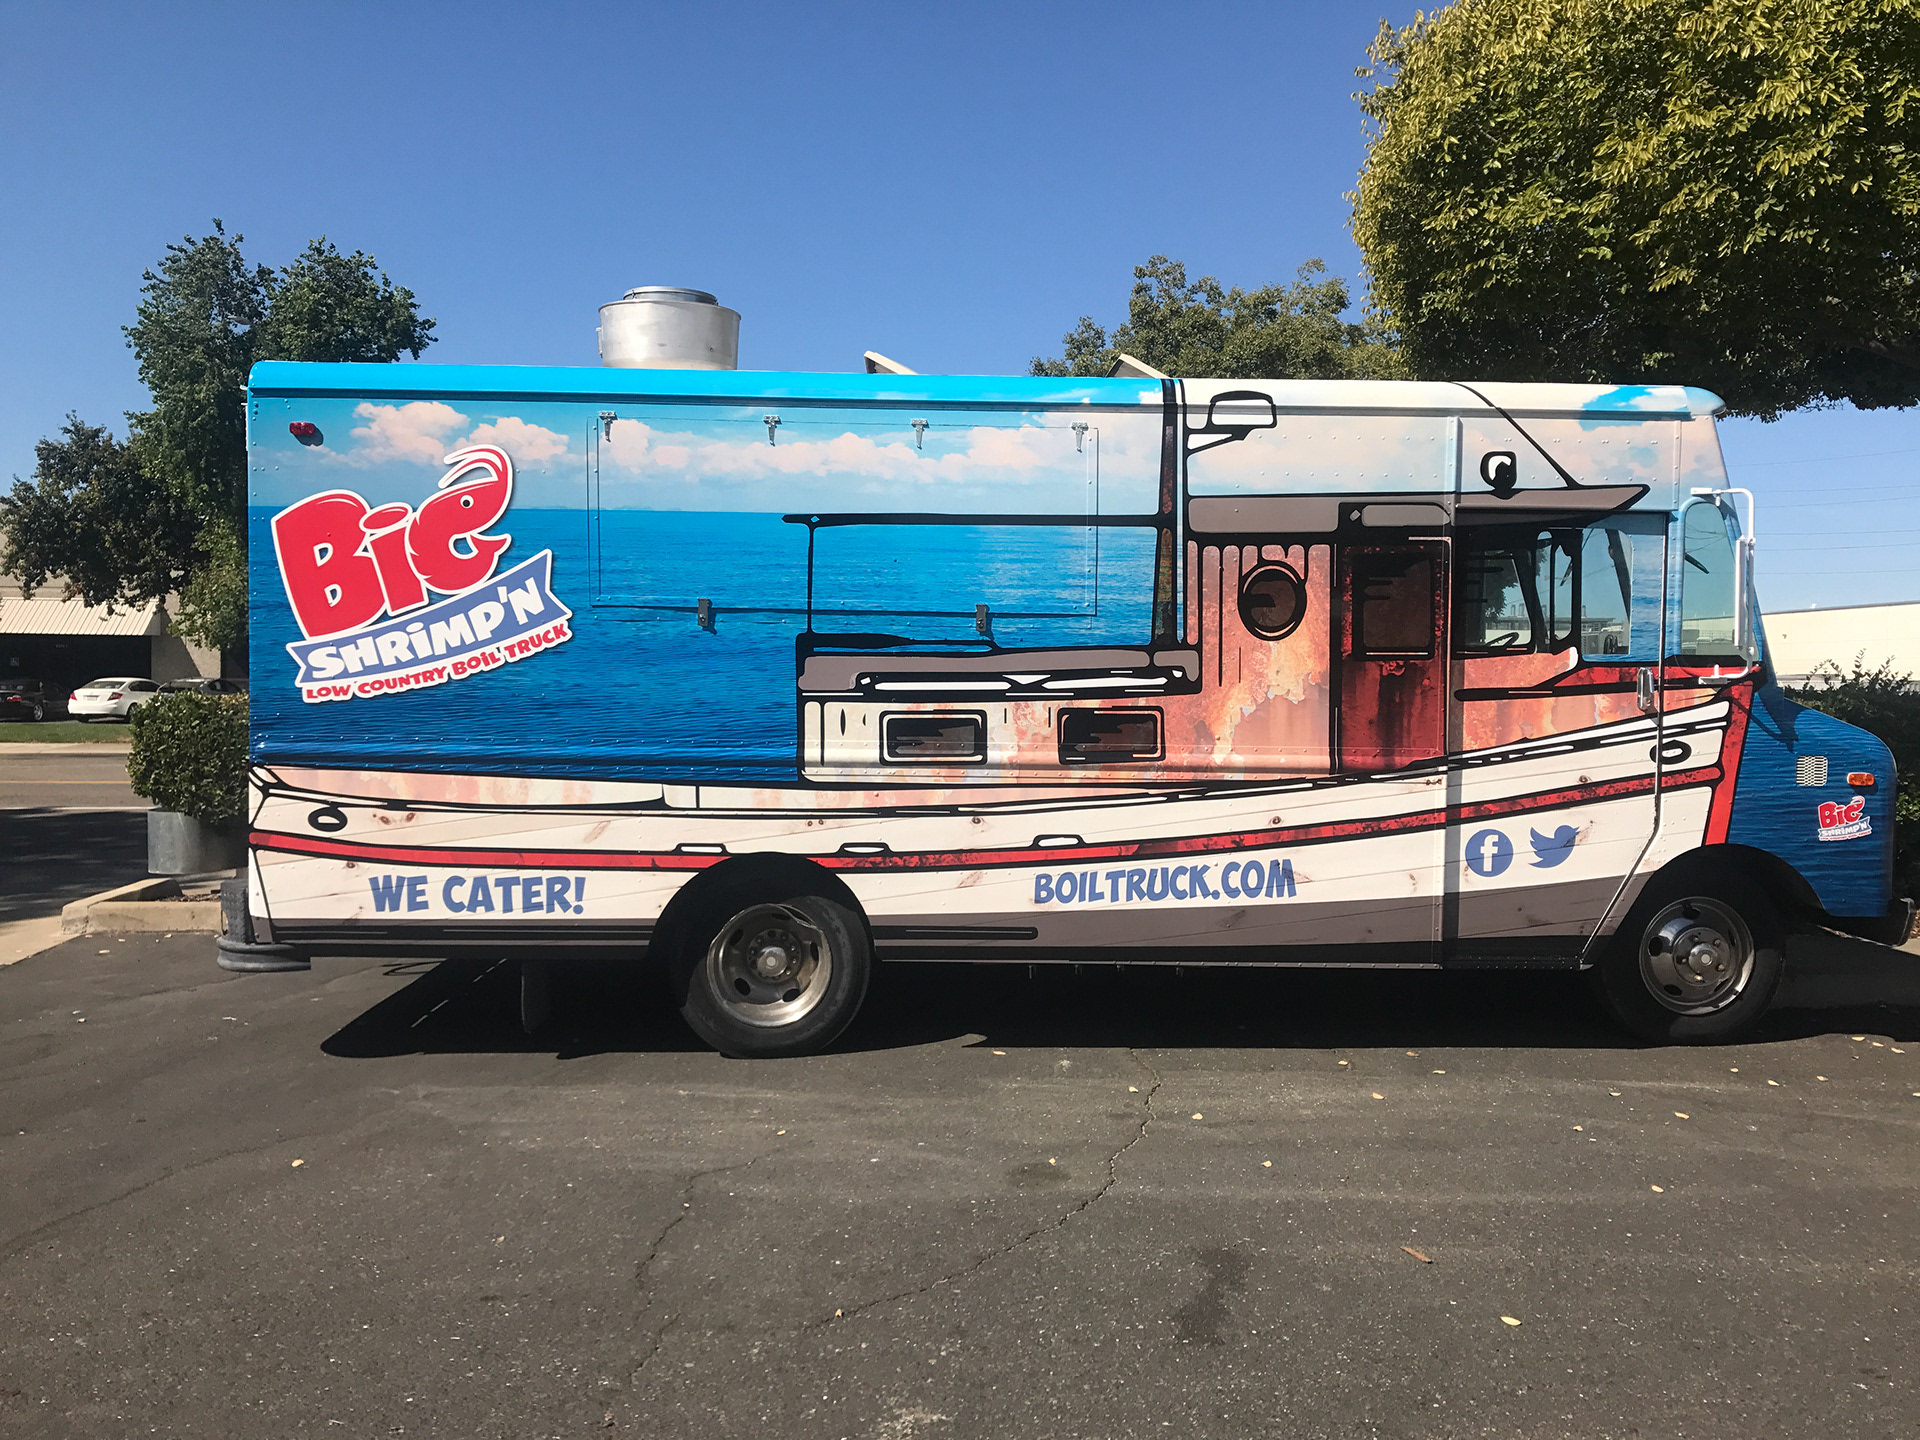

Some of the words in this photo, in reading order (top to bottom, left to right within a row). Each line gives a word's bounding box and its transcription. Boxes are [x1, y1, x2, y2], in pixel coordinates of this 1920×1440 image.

[306, 684, 352, 699] LOW
[357, 666, 447, 694] COUNTRY
[503, 624, 568, 658] TRUCK
[368, 874, 430, 913] WE
[442, 875, 586, 915] CATER!
[1033, 858, 1297, 904] BOILTRUCK.COM
